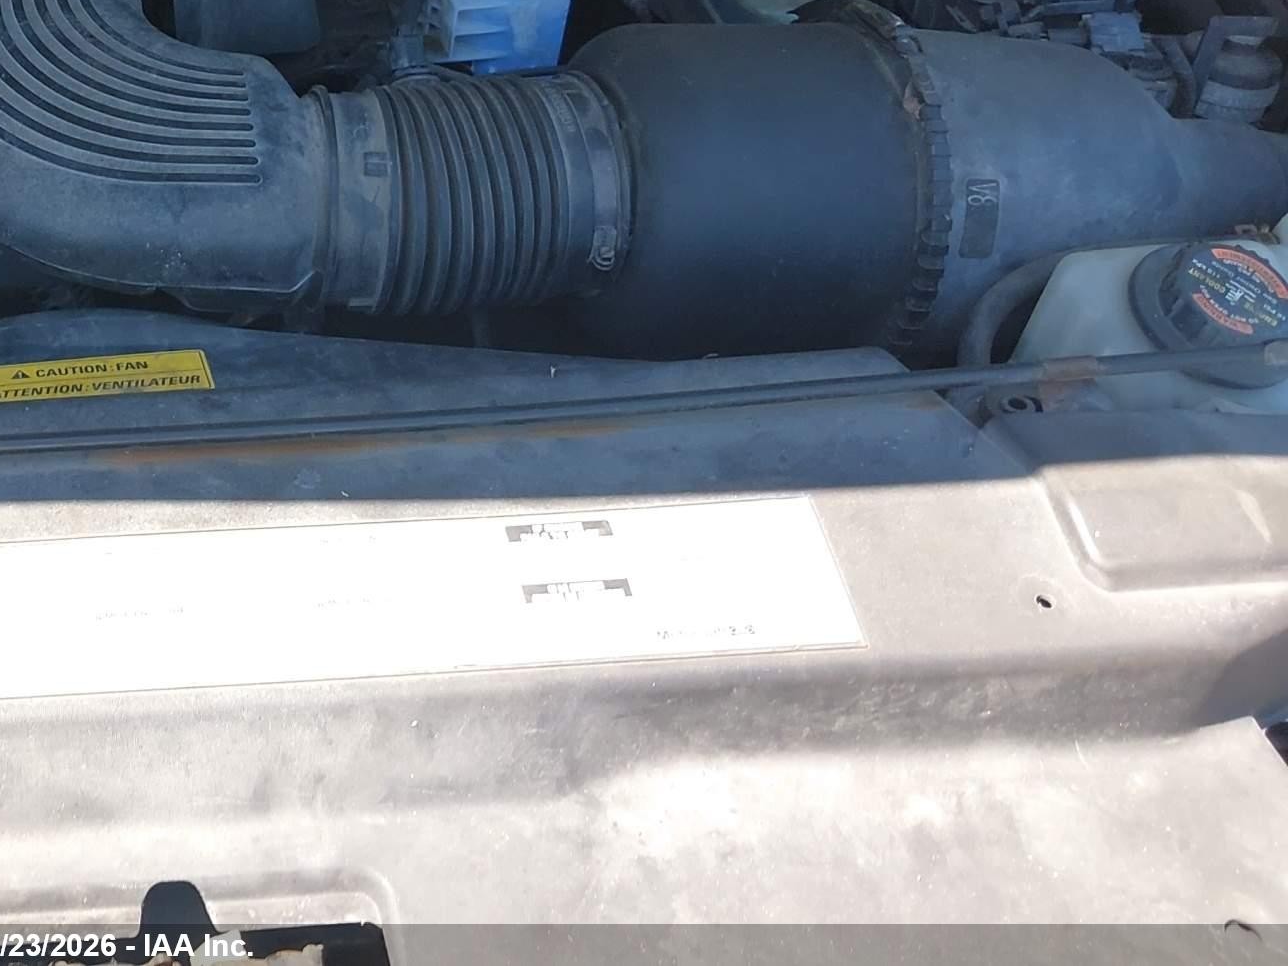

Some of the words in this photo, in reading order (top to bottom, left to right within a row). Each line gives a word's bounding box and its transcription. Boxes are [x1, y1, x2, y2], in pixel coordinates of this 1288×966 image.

[968, 182, 998, 207] V8
[116, 361, 149, 372] FAN
[91, 374, 201, 391] VENTILATEUR
